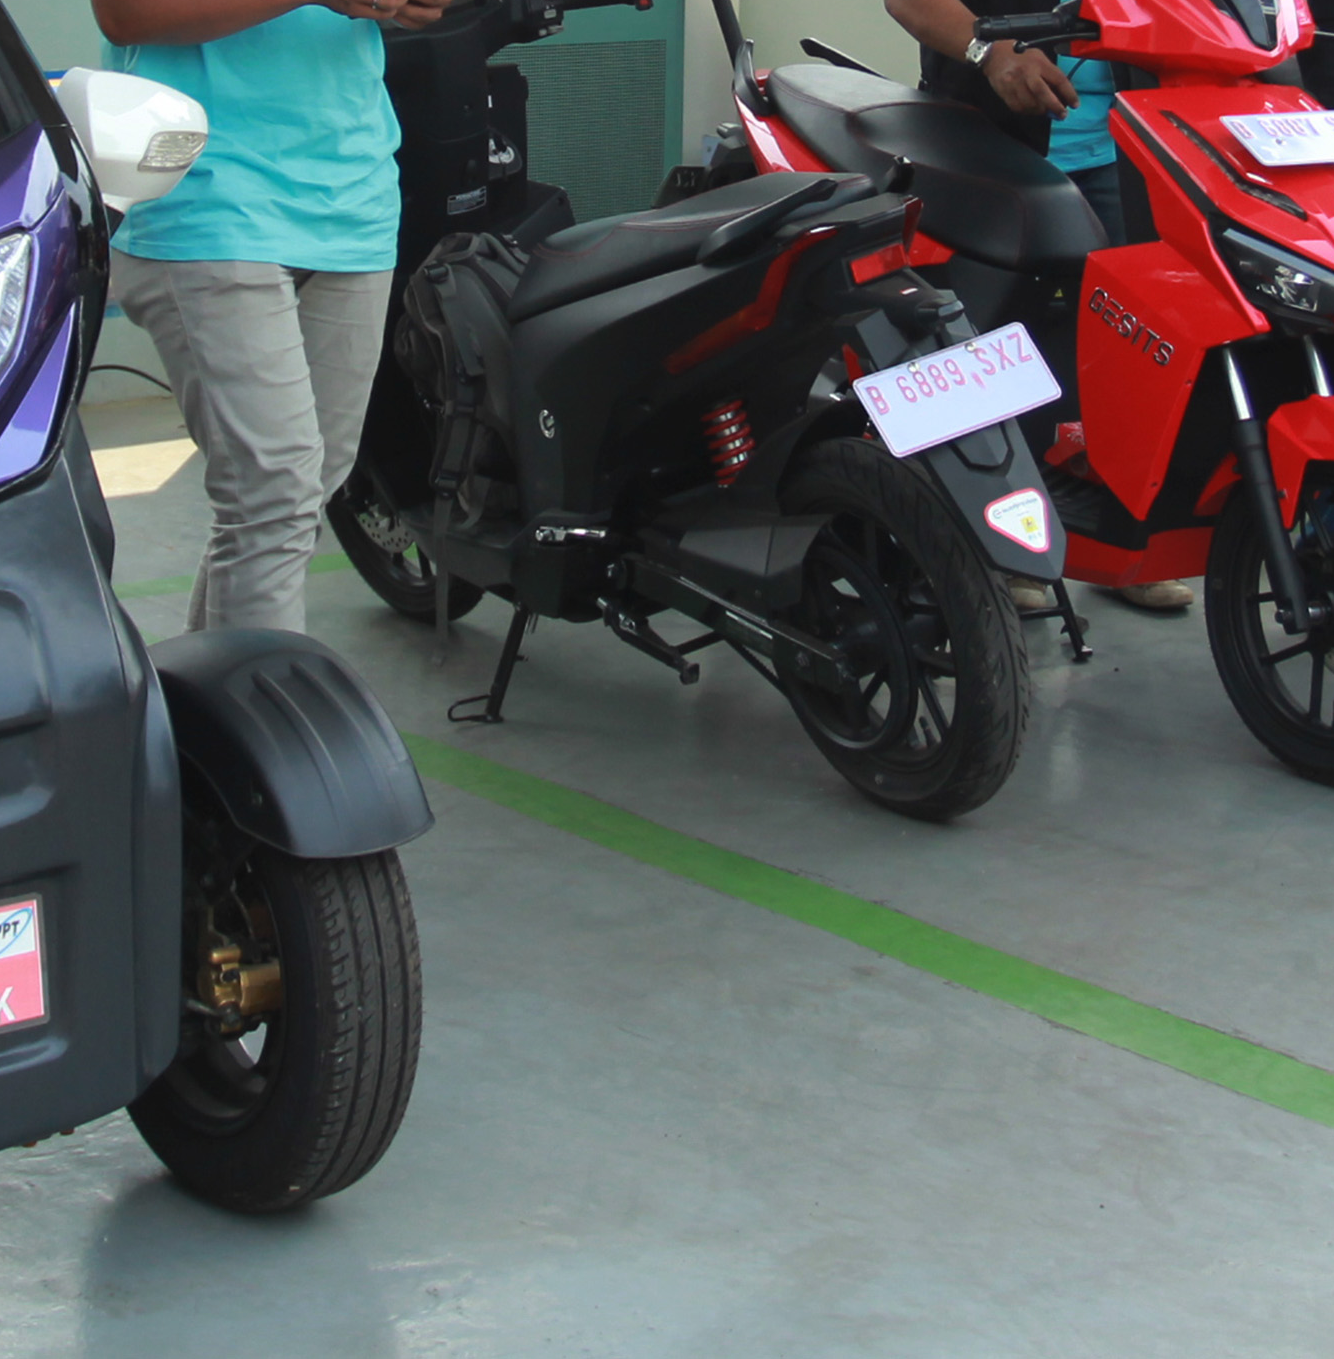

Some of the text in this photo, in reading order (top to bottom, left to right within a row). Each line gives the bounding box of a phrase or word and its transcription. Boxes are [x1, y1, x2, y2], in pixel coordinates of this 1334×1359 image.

[1089, 286, 1175, 366] GESITS
[865, 331, 1035, 416] B 6889 SXZ
